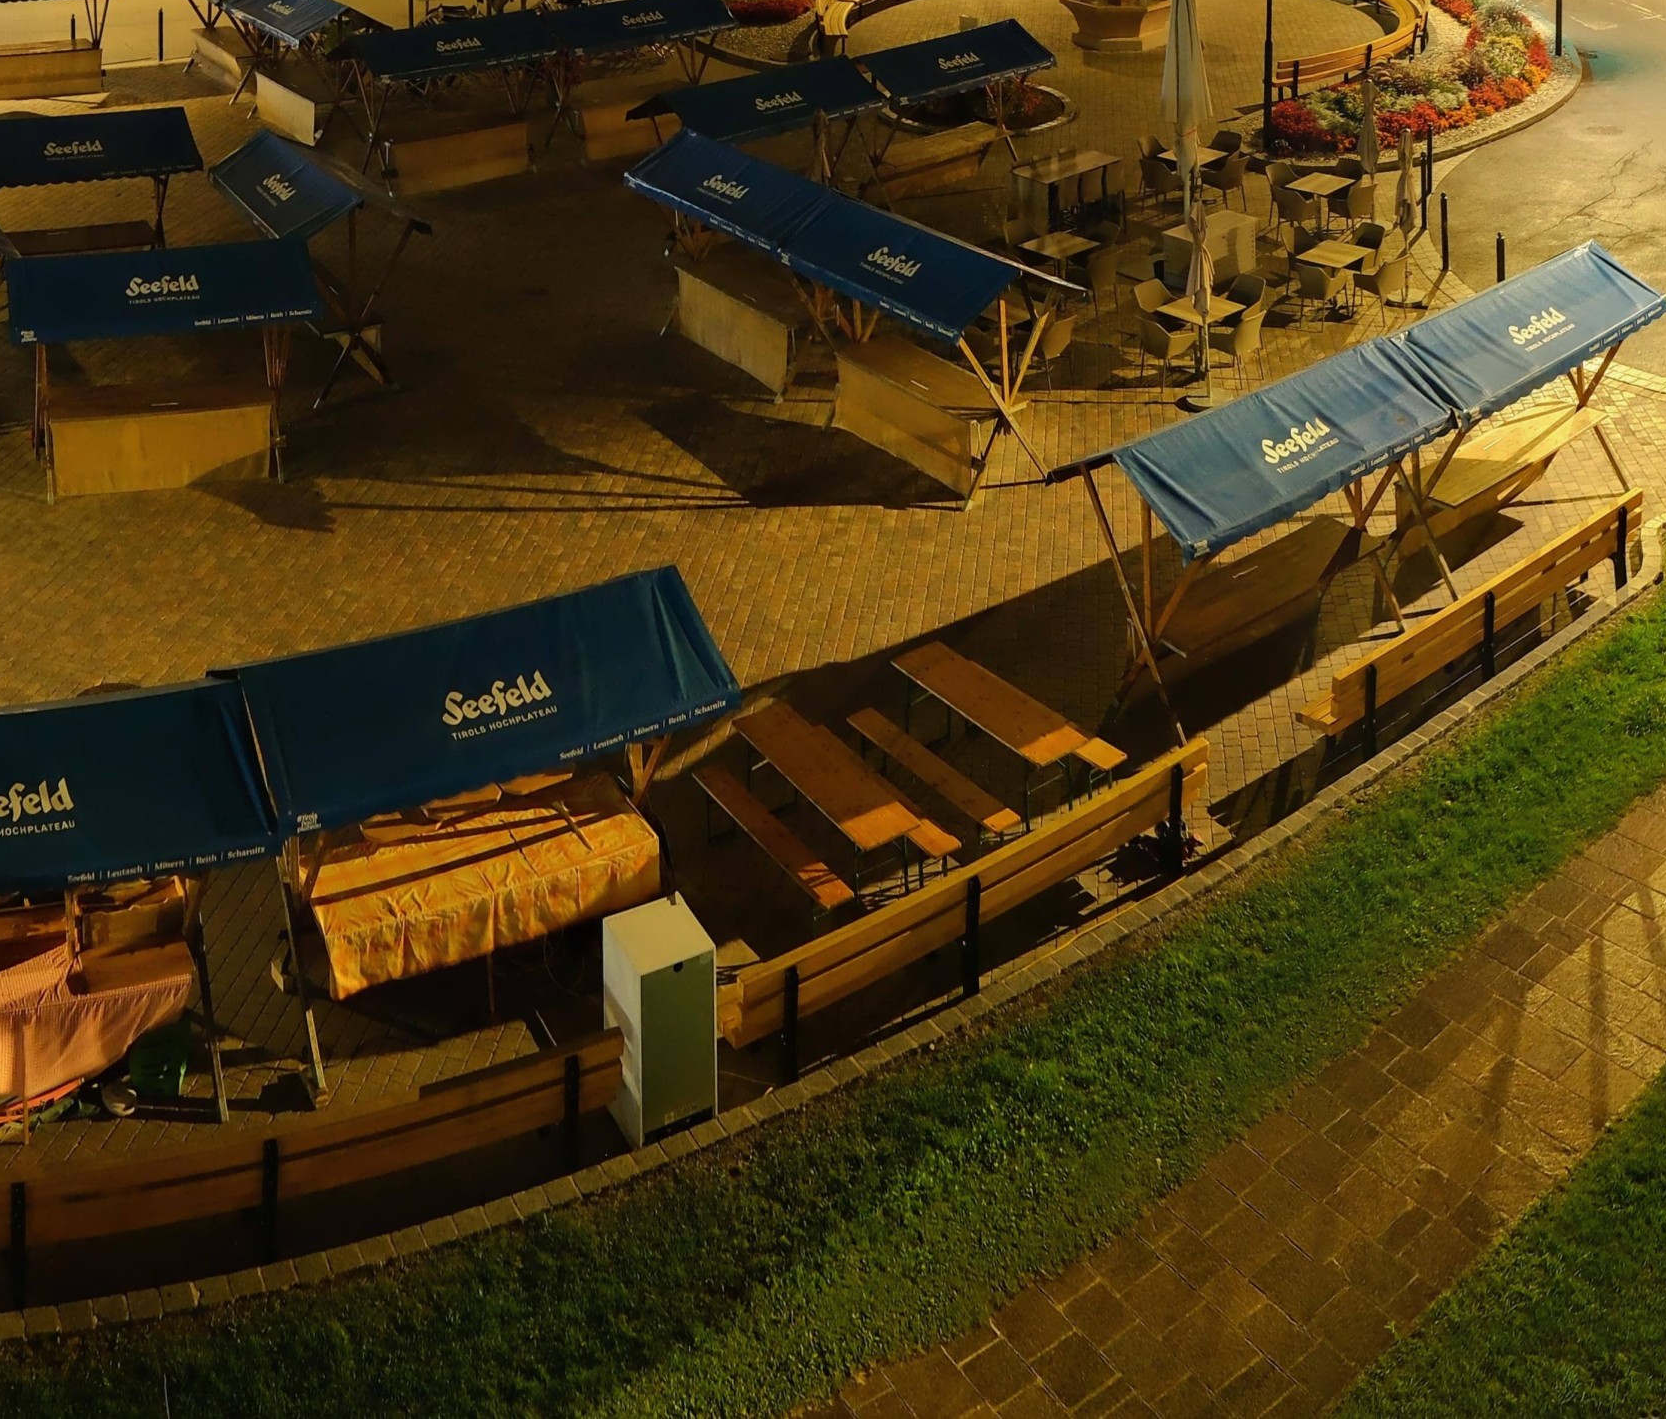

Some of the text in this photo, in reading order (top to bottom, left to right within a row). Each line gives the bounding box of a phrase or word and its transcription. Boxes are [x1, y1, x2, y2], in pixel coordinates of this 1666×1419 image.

[622, 11, 664, 27] Seefeld
[436, 37, 482, 52] Seefeld
[938, 52, 981, 70] Seefeld
[755, 91, 803, 111] Seefeld
[43, 140, 103, 156] Seefeld
[703, 174, 750, 200] Seefeld
[867, 246, 922, 278] Seefeld
[125, 274, 199, 297] Seefeld
[1508, 306, 1567, 345] Seefeld
[1261, 417, 1331, 464] Seefeld
[1276, 460, 1299, 474] TIROLS
[442, 669, 553, 726] Seefeld
[451, 705, 558, 741] TIROLS HOCHPLATEAU
[559, 699, 727, 761] Seefeld Leutasch Mösern Reith Scharnitz
[106, 863, 144, 879] Leutasch
[154, 857, 185, 872] Mösern
[195, 852, 218, 866] Reith
[226, 845, 266, 860] Scharnitz
